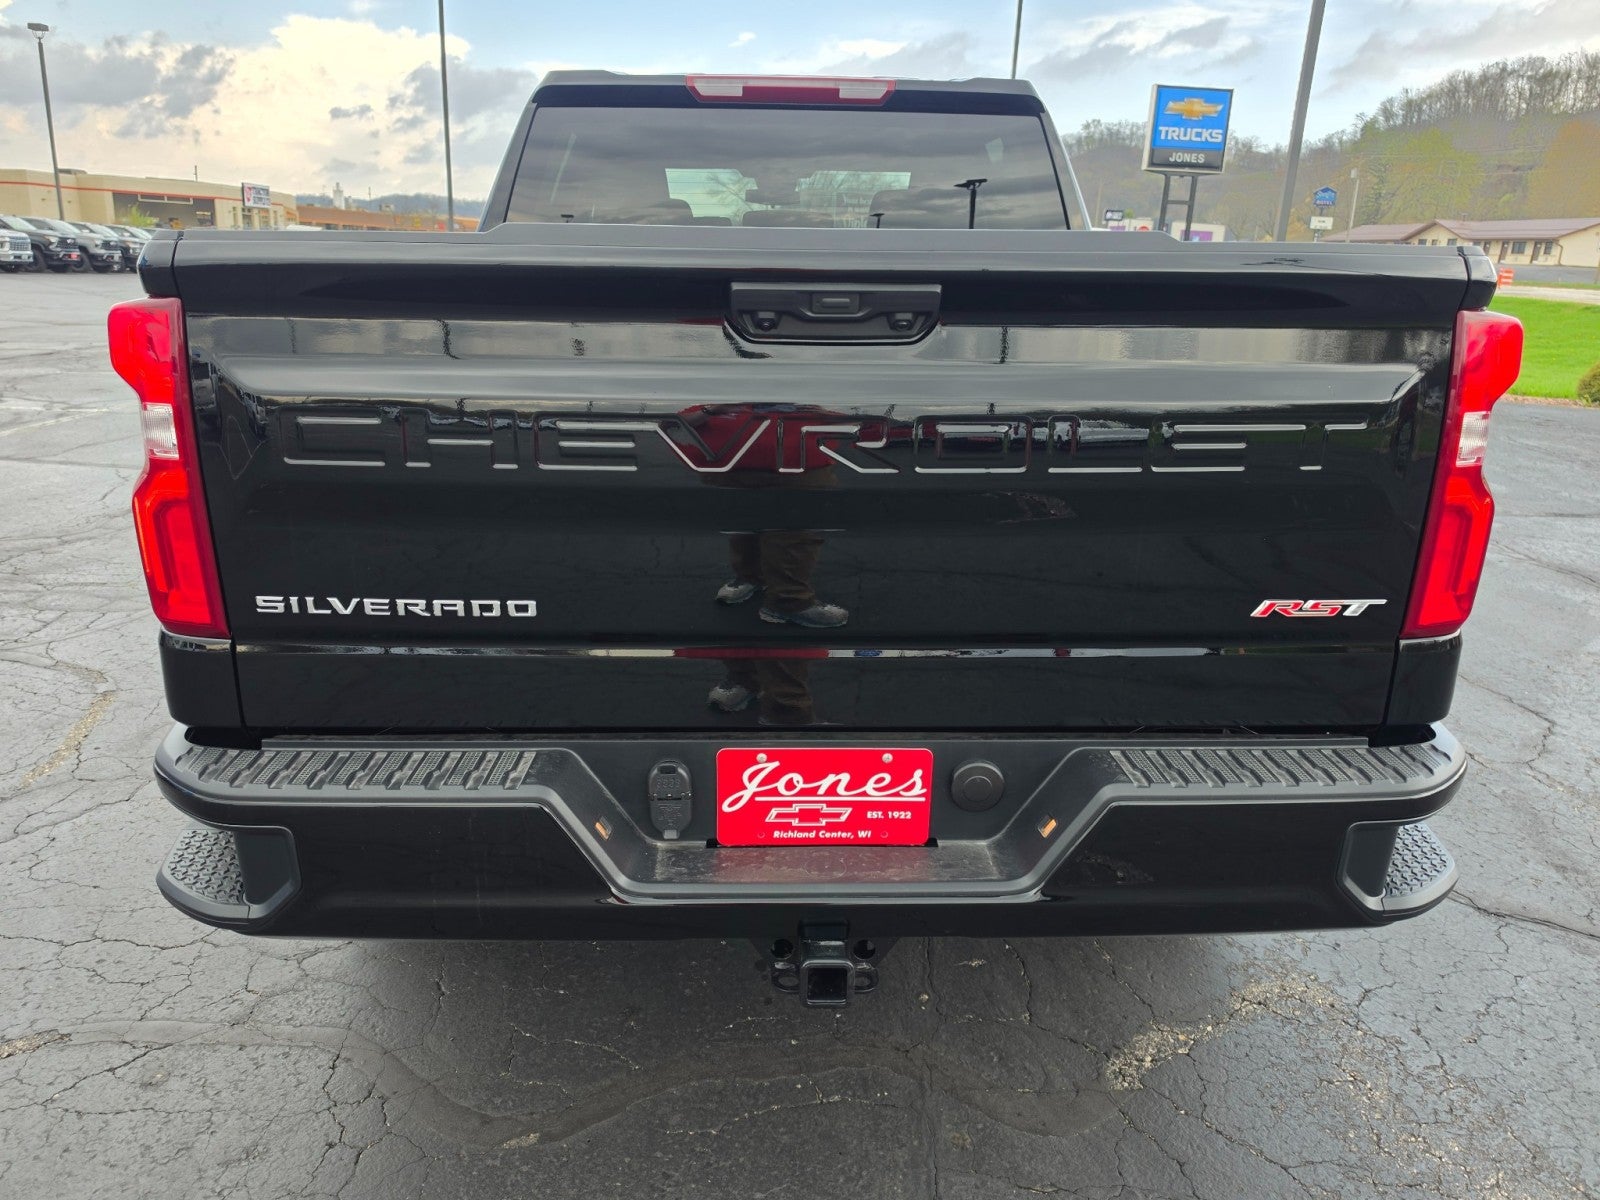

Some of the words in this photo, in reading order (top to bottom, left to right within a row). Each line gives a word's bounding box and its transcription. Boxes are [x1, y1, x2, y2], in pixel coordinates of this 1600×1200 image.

[1158, 126, 1223, 142] TRUCKS
[1169, 152, 1205, 163] JONES
[279, 406, 1368, 473] CHEVROLET
[255, 595, 537, 617] SILVERADO
[1250, 599, 1387, 617] RST
[722, 761, 927, 813] Jones
[867, 811, 884, 819] EST.
[888, 811, 911, 819] 1922
[773, 830, 815, 839] Richland
[819, 830, 854, 839] Center,
[858, 830, 871, 838] WI
